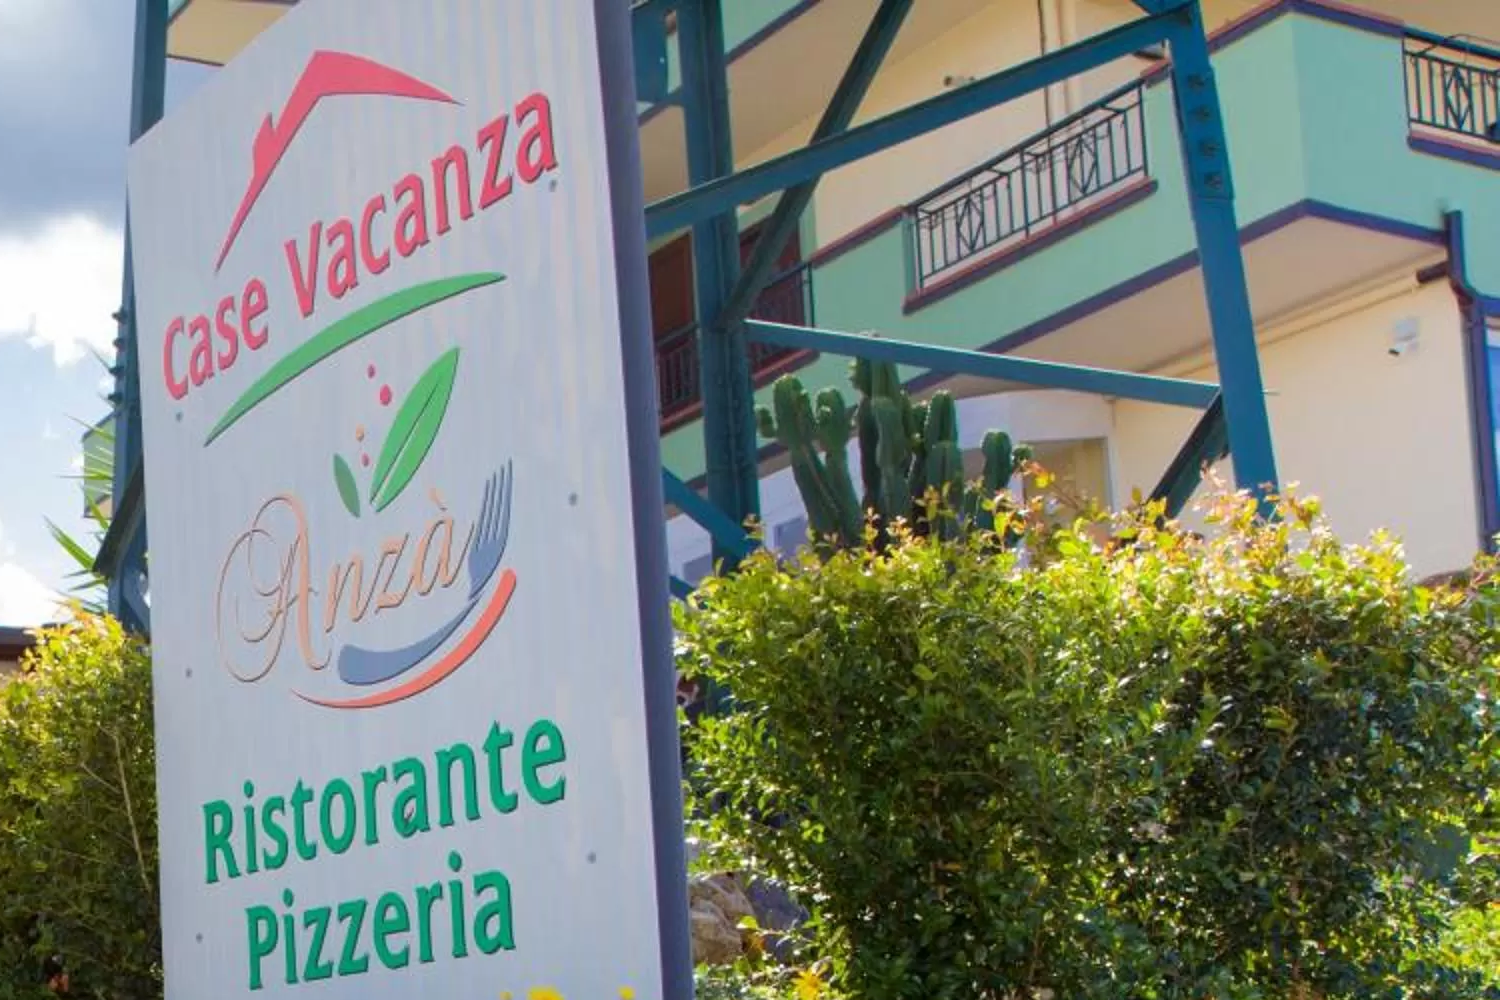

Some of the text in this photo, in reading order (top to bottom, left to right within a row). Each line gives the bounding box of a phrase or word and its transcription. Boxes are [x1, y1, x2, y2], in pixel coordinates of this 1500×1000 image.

[163, 91, 558, 400] Case Vacanza
[215, 487, 475, 682] Anzà
[202, 718, 566, 884] Ristorante
[245, 850, 516, 990] Pizzeria
